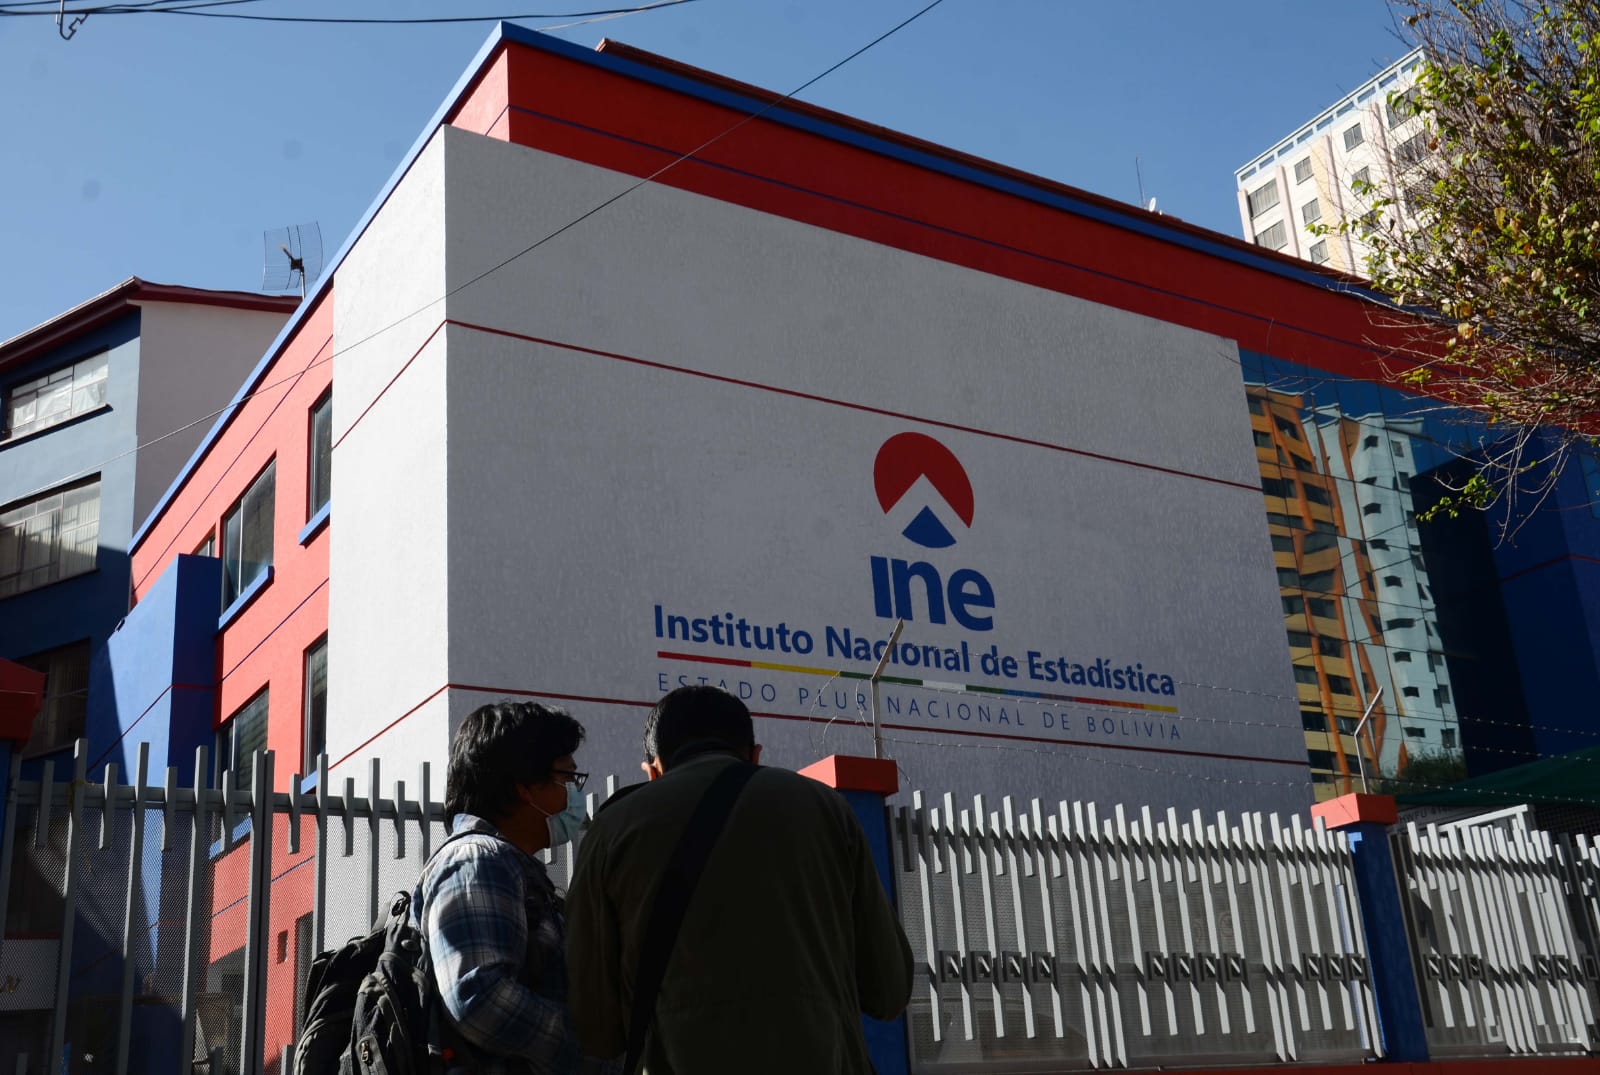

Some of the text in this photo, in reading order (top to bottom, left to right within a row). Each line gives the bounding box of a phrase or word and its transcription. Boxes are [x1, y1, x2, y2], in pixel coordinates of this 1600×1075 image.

[654, 604, 1176, 696] Instituto Nacional de Estadística
[799, 687, 1025, 726] PLURNACIONAL
[1043, 711, 1070, 730] DE
[1087, 715, 1181, 740] BOLIVIA
